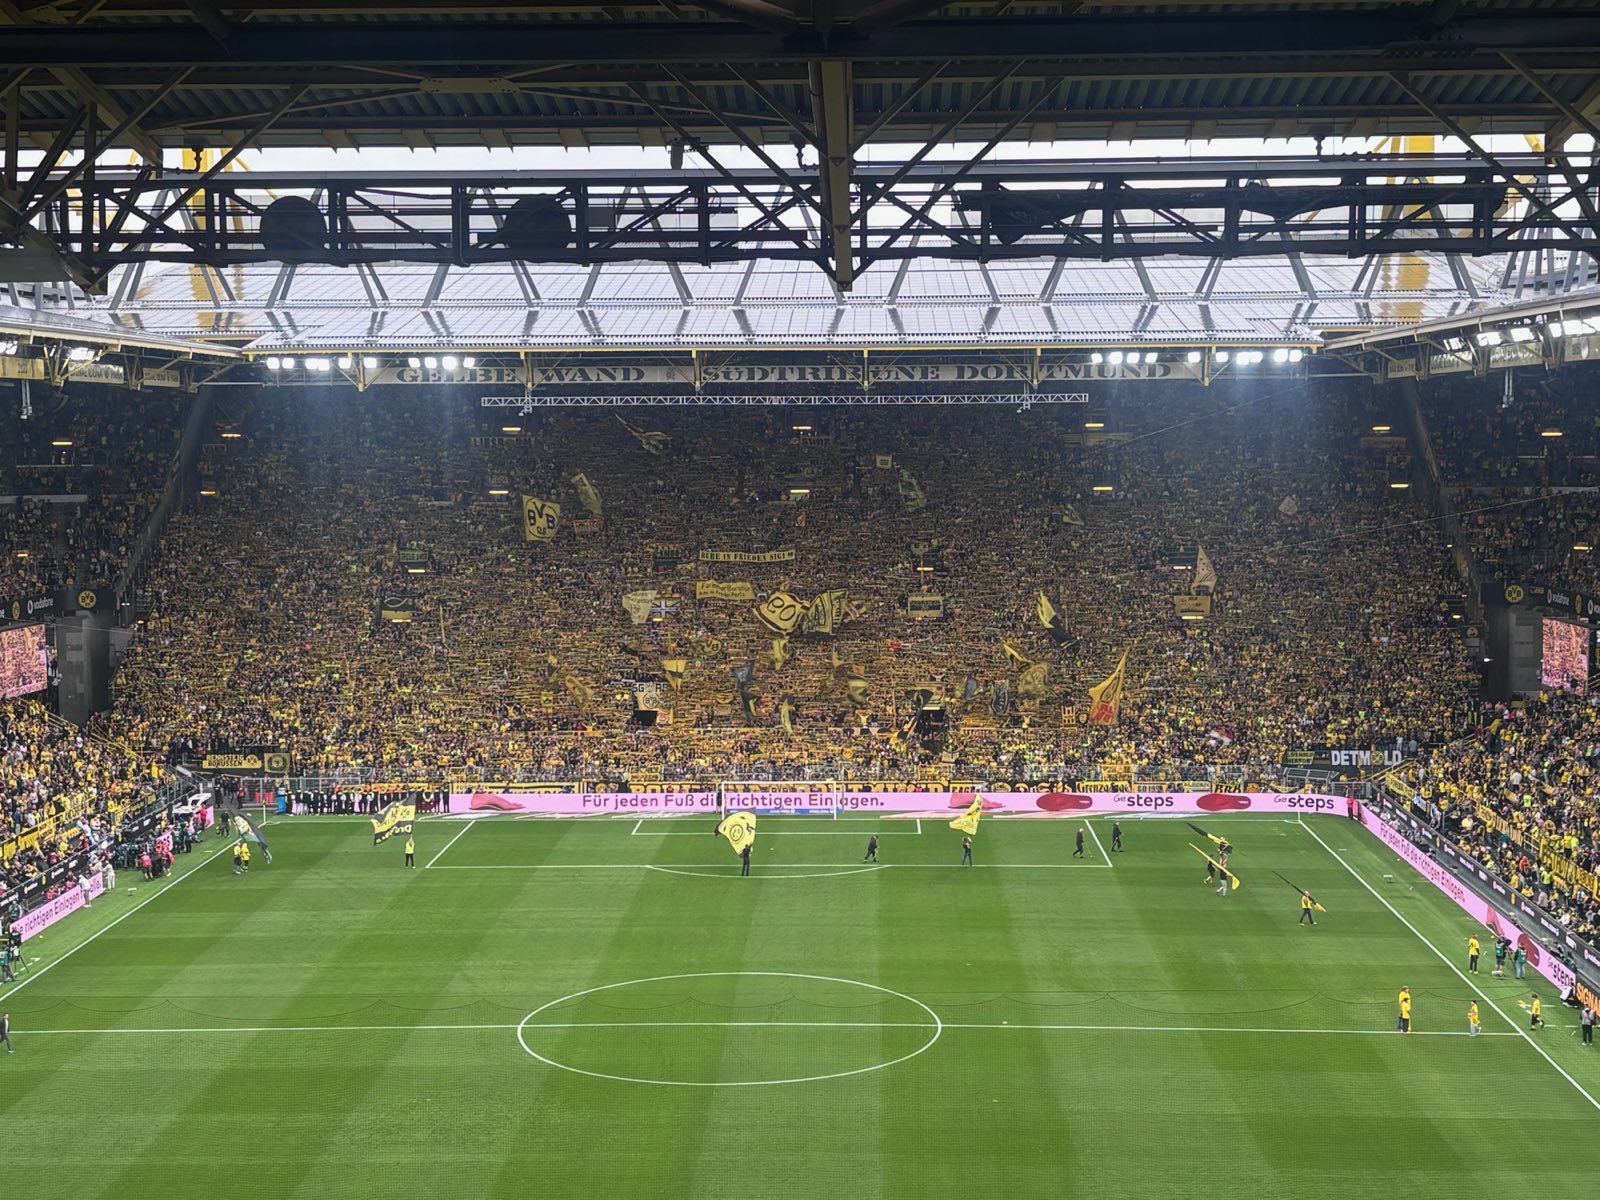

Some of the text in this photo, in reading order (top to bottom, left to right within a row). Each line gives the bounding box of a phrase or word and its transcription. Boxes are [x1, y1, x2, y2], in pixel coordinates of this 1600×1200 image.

[396, 367, 645, 383] GELBE WAND
[702, 363, 1171, 381] SÜDTRIBÜNE DORTMUND
[528, 501, 556, 529] BVB
[582, 793, 885, 810] Für jeden Fuß di richtigen Einagen.
[1127, 794, 1174, 810] steps
[1287, 795, 1335, 811] steps
